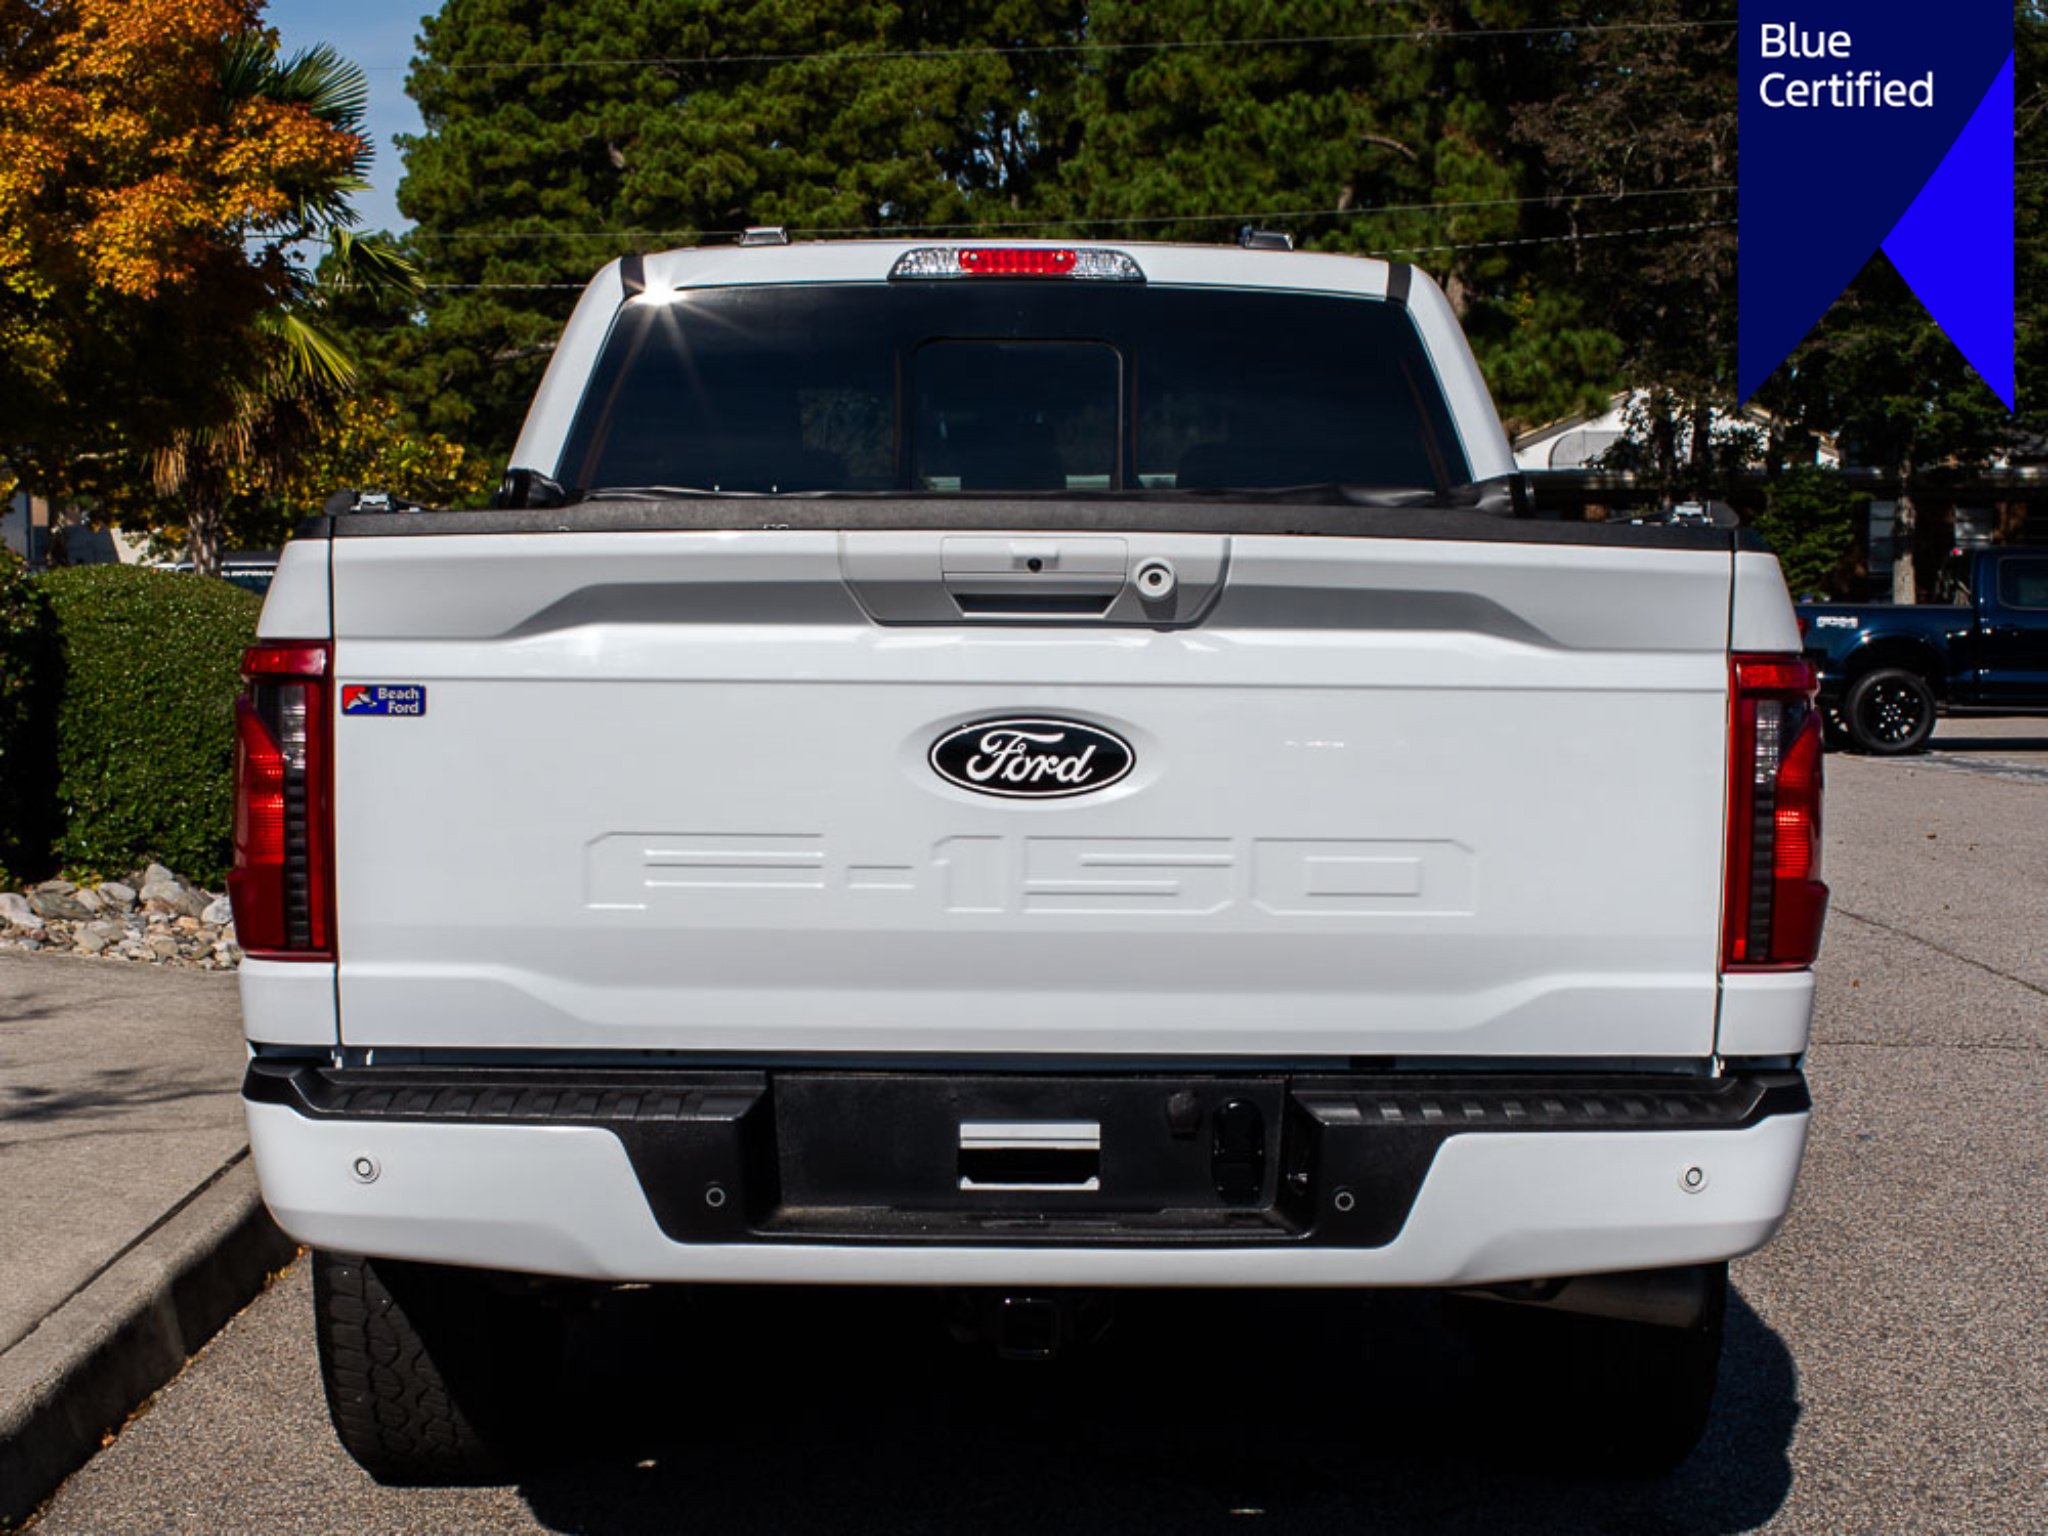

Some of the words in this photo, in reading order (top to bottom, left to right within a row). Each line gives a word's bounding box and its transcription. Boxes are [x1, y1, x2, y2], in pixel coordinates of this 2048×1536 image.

[378, 688, 420, 700] Beach
[388, 701, 420, 714] Ford
[966, 730, 1096, 783] Ford
[584, 831, 1476, 916] F-150
